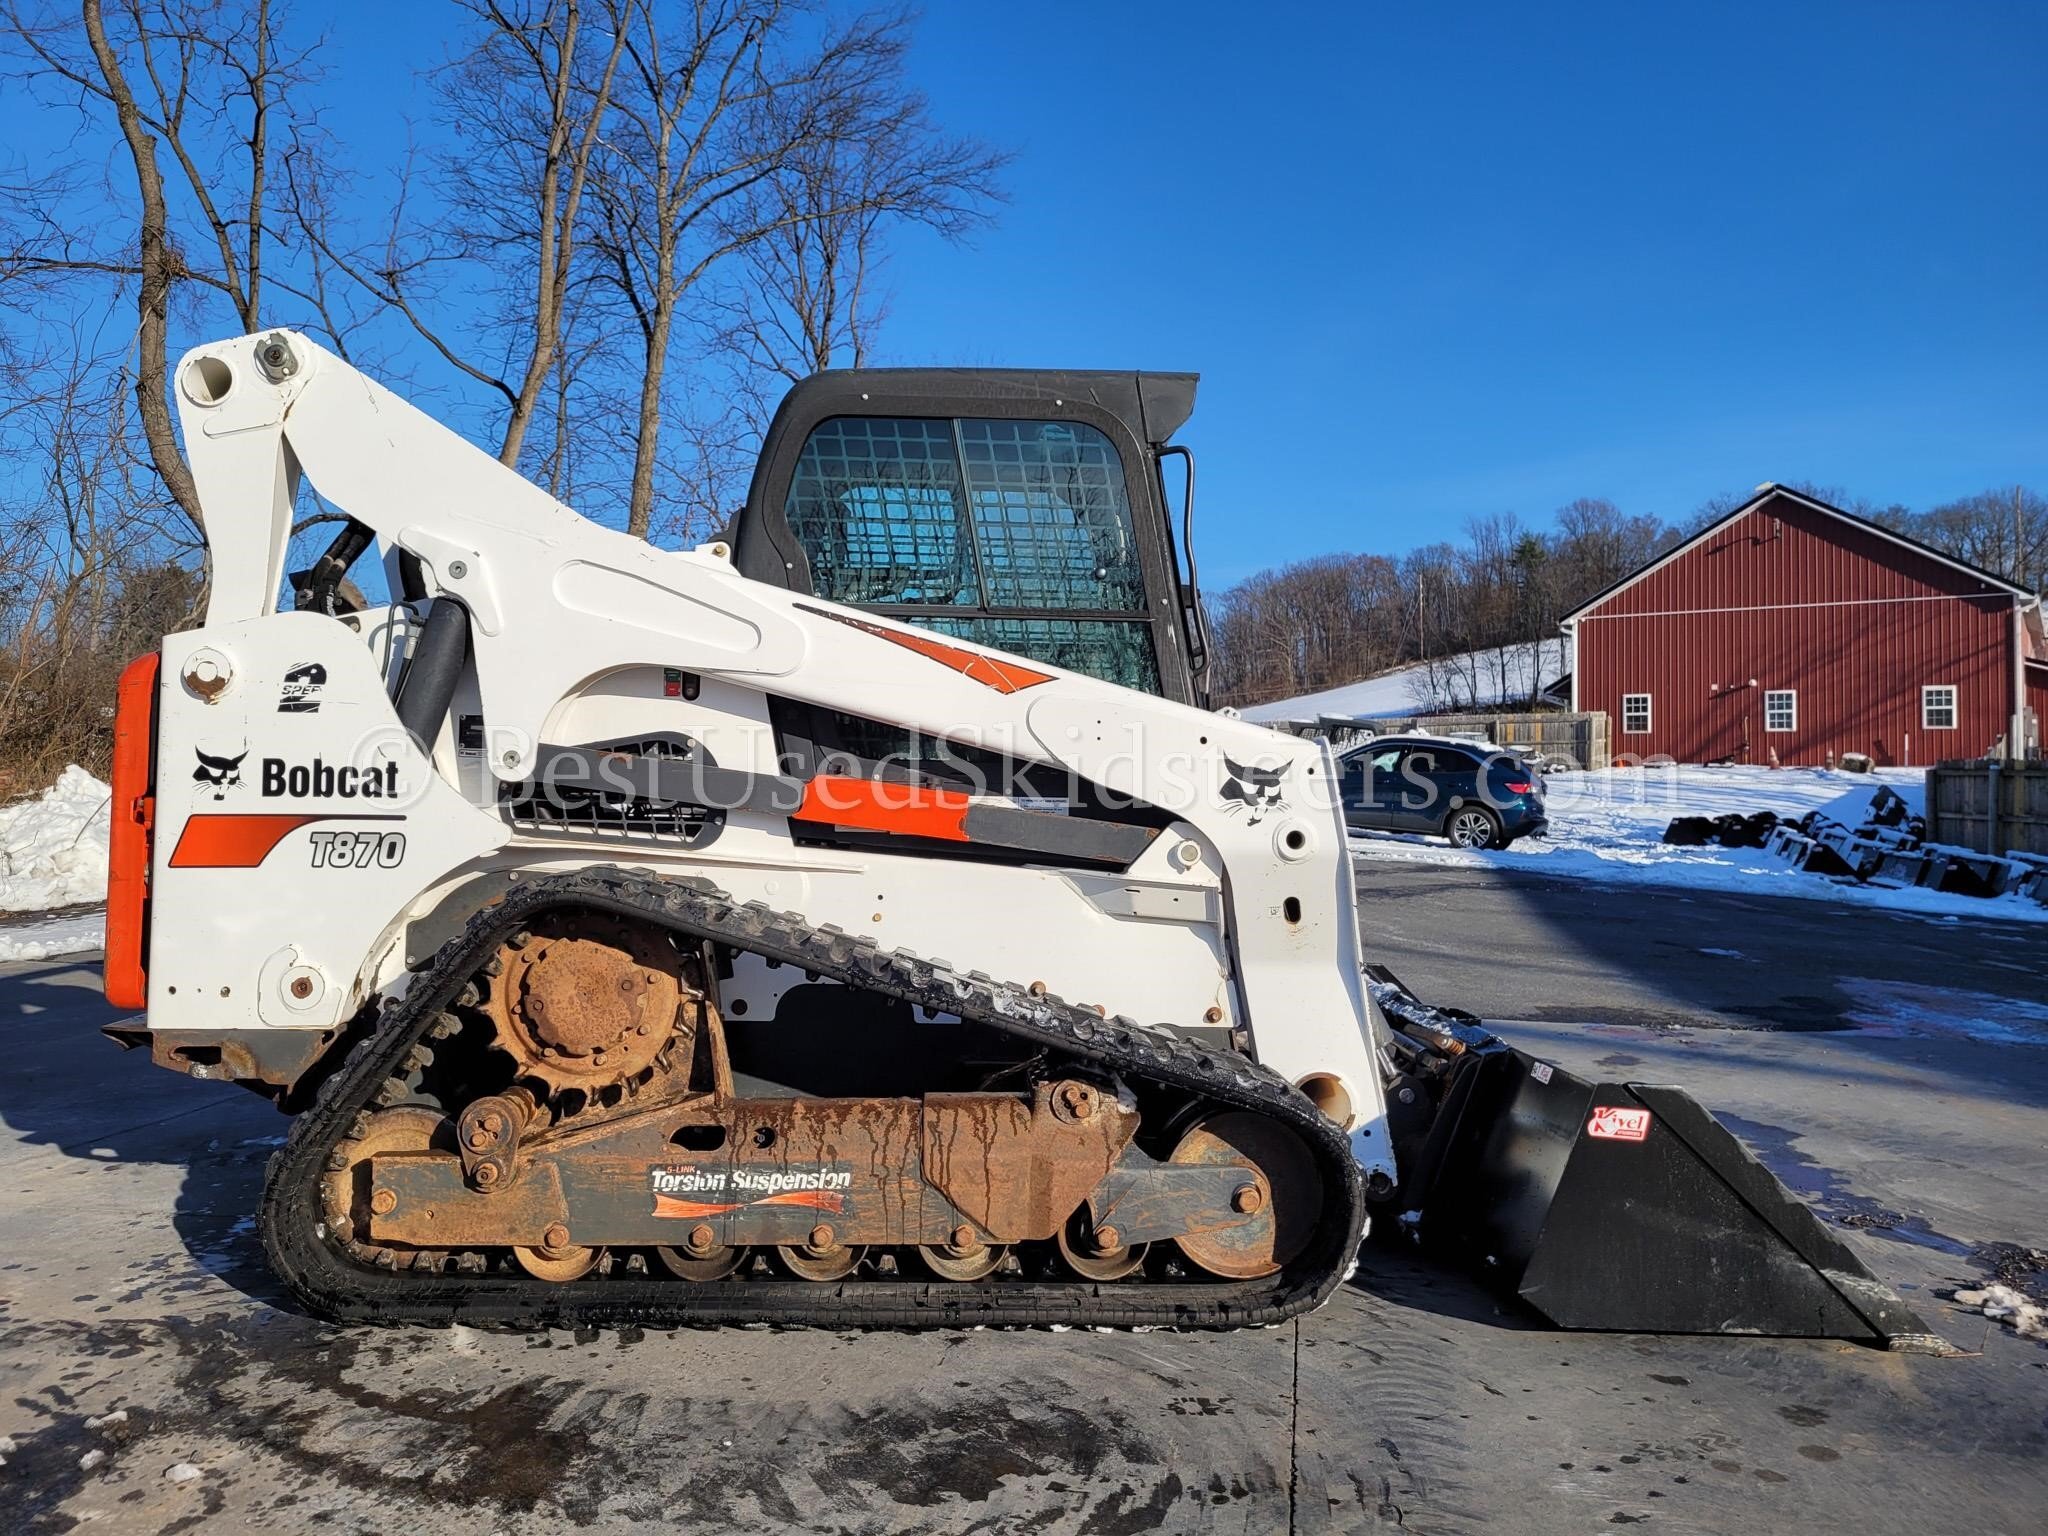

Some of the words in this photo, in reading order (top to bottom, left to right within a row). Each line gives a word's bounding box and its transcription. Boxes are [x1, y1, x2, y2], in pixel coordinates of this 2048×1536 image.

[262, 758, 398, 798] Bobcat
[310, 832, 406, 868] T870
[1592, 1108, 1644, 1133] Kivel
[652, 1170, 726, 1191] Torsion
[731, 1168, 851, 1194] Suspension
